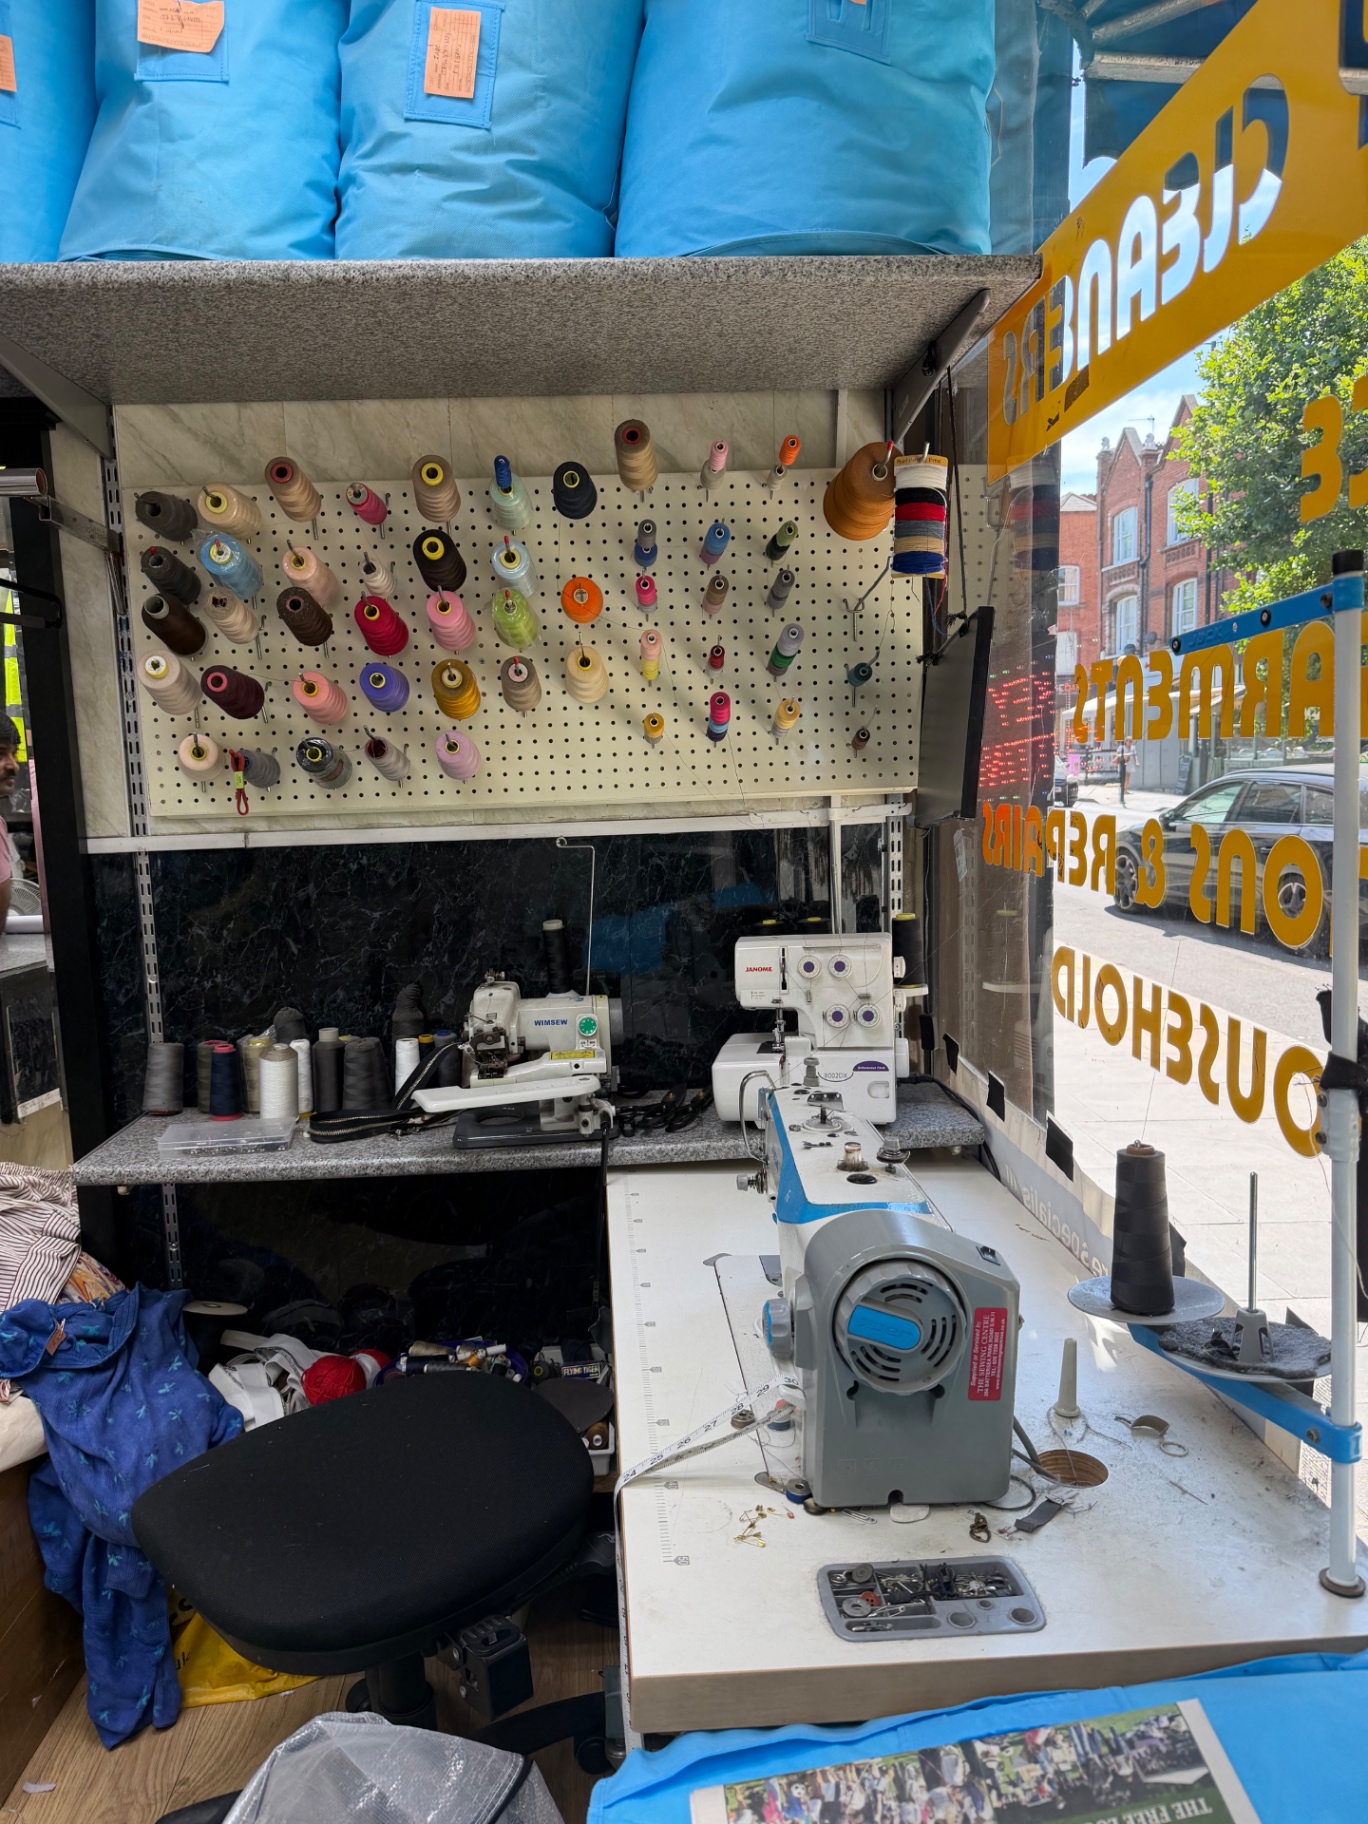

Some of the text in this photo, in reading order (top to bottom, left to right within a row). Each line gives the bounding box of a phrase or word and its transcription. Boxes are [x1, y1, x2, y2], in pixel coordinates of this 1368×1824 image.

[977, 1315, 990, 1393] THE SEWING CENTRE
[984, 1356, 992, 1388] BATTERSEA
[623, 1376, 799, 1482] 24 25 26 27 28 29 30
[1171, 1797, 1213, 1819] THE
